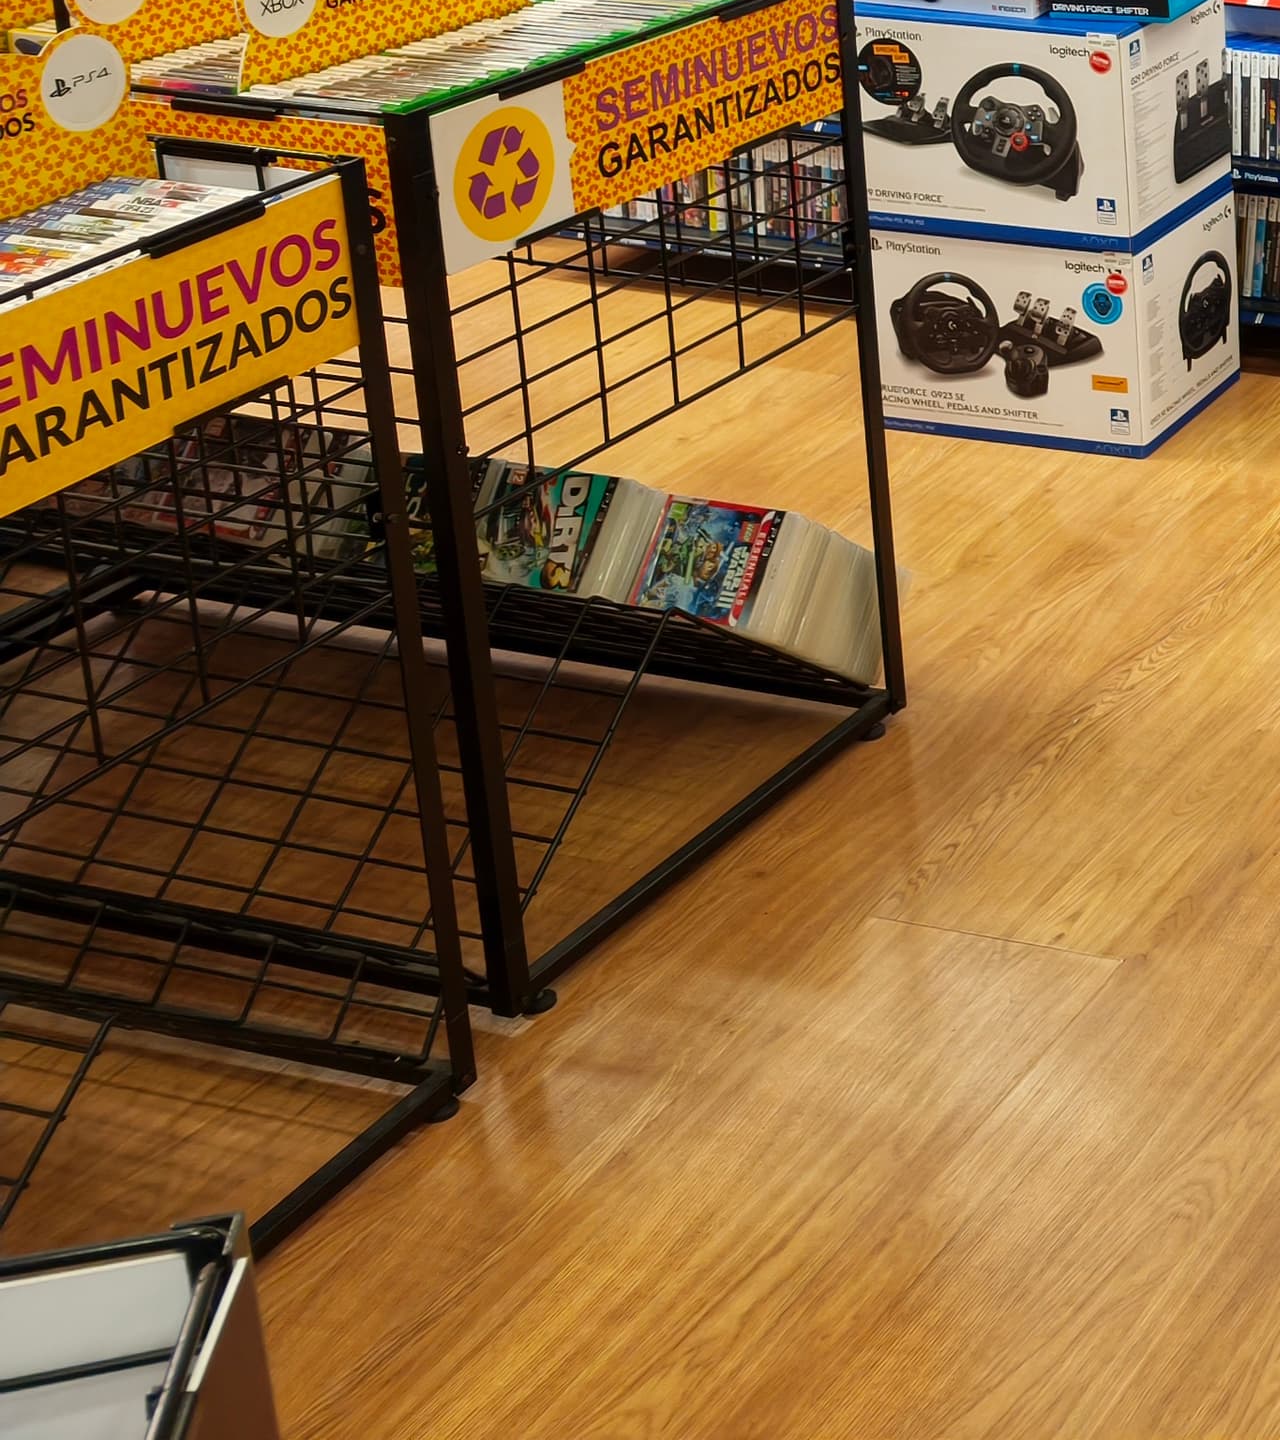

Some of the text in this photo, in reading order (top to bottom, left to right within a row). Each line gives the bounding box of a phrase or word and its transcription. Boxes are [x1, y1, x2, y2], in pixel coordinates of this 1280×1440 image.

[598, 2, 841, 132] SEMINUEVOS
[599, 51, 842, 179] GARANTIZADOS
[1049, 44, 1090, 59] logitech
[0, 219, 341, 413] EMINUEVOS
[0, 276, 352, 475] ARANTIZADOS
